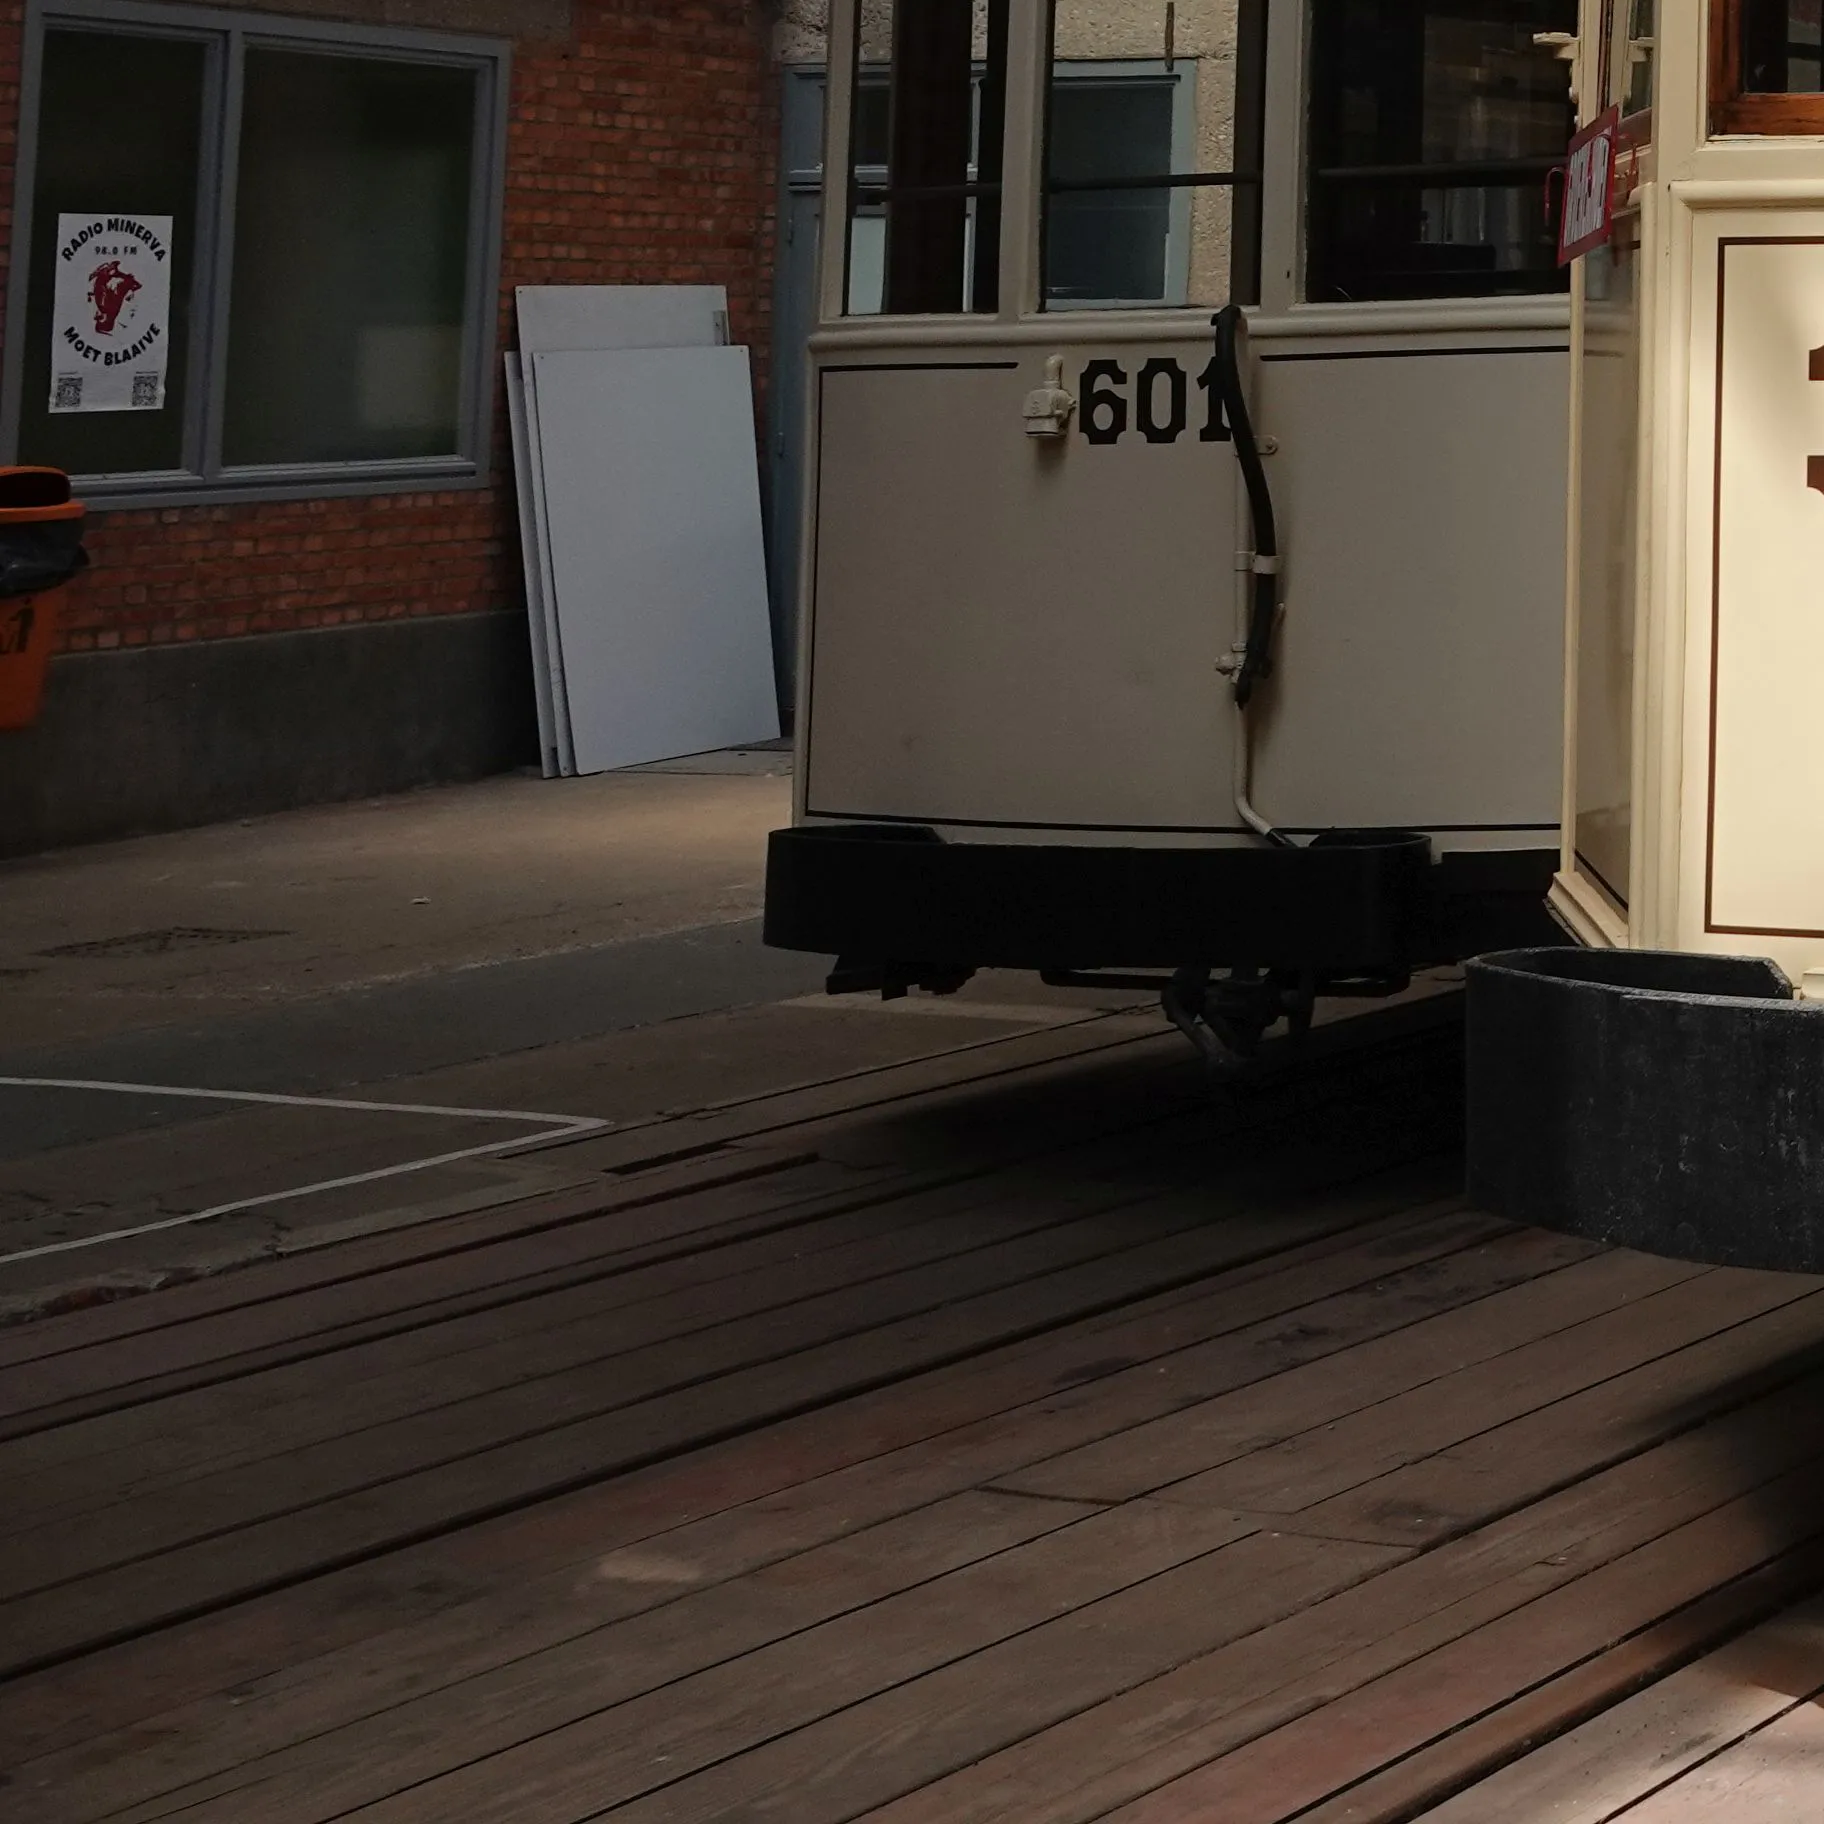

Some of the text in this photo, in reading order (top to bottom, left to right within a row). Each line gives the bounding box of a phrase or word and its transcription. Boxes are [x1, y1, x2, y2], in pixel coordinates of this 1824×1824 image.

[61, 218, 168, 263] RADIO MINERVA
[63, 322, 161, 367] MOET BLAAIVE
[1079, 357, 1232, 445] 601
